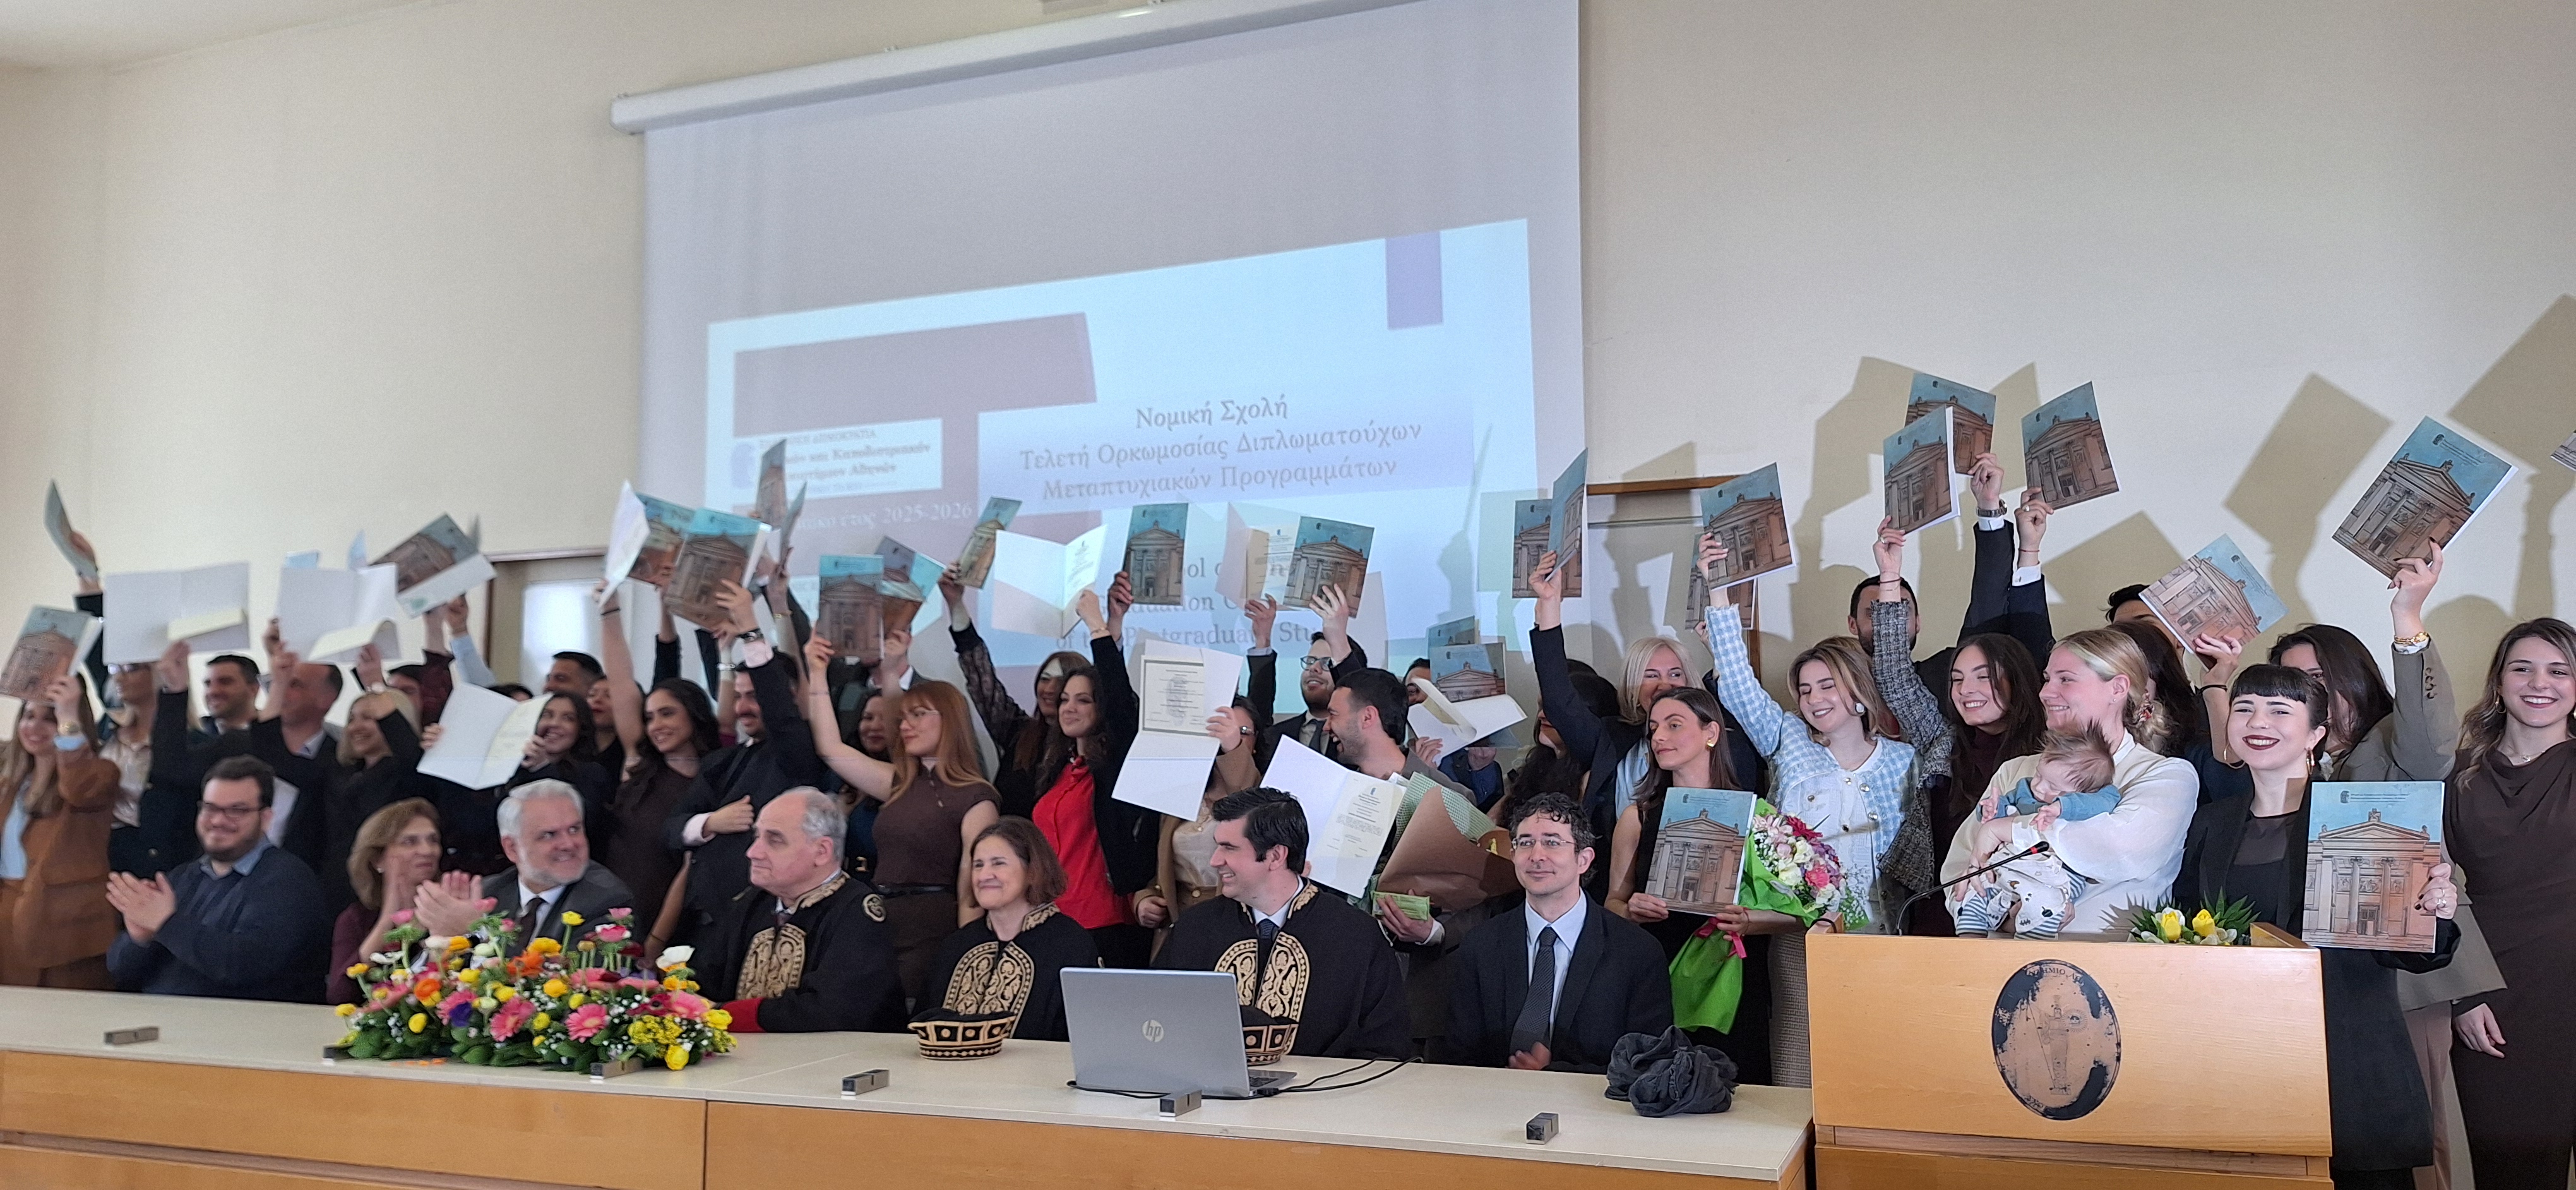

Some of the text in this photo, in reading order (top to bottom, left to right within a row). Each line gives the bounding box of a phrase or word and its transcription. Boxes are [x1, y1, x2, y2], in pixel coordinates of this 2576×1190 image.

[1136, 393, 1287, 431] Νομική Σχολή
[1020, 420, 1421, 470] Τελετή Ορκωμοσίας Διπλωματούχων
[1043, 456, 1397, 499] Μεταπτυχιακών Προγραμμάτων
[882, 502, 973, 524] 2025-2026
[1145, 1020, 1162, 1042] hp
